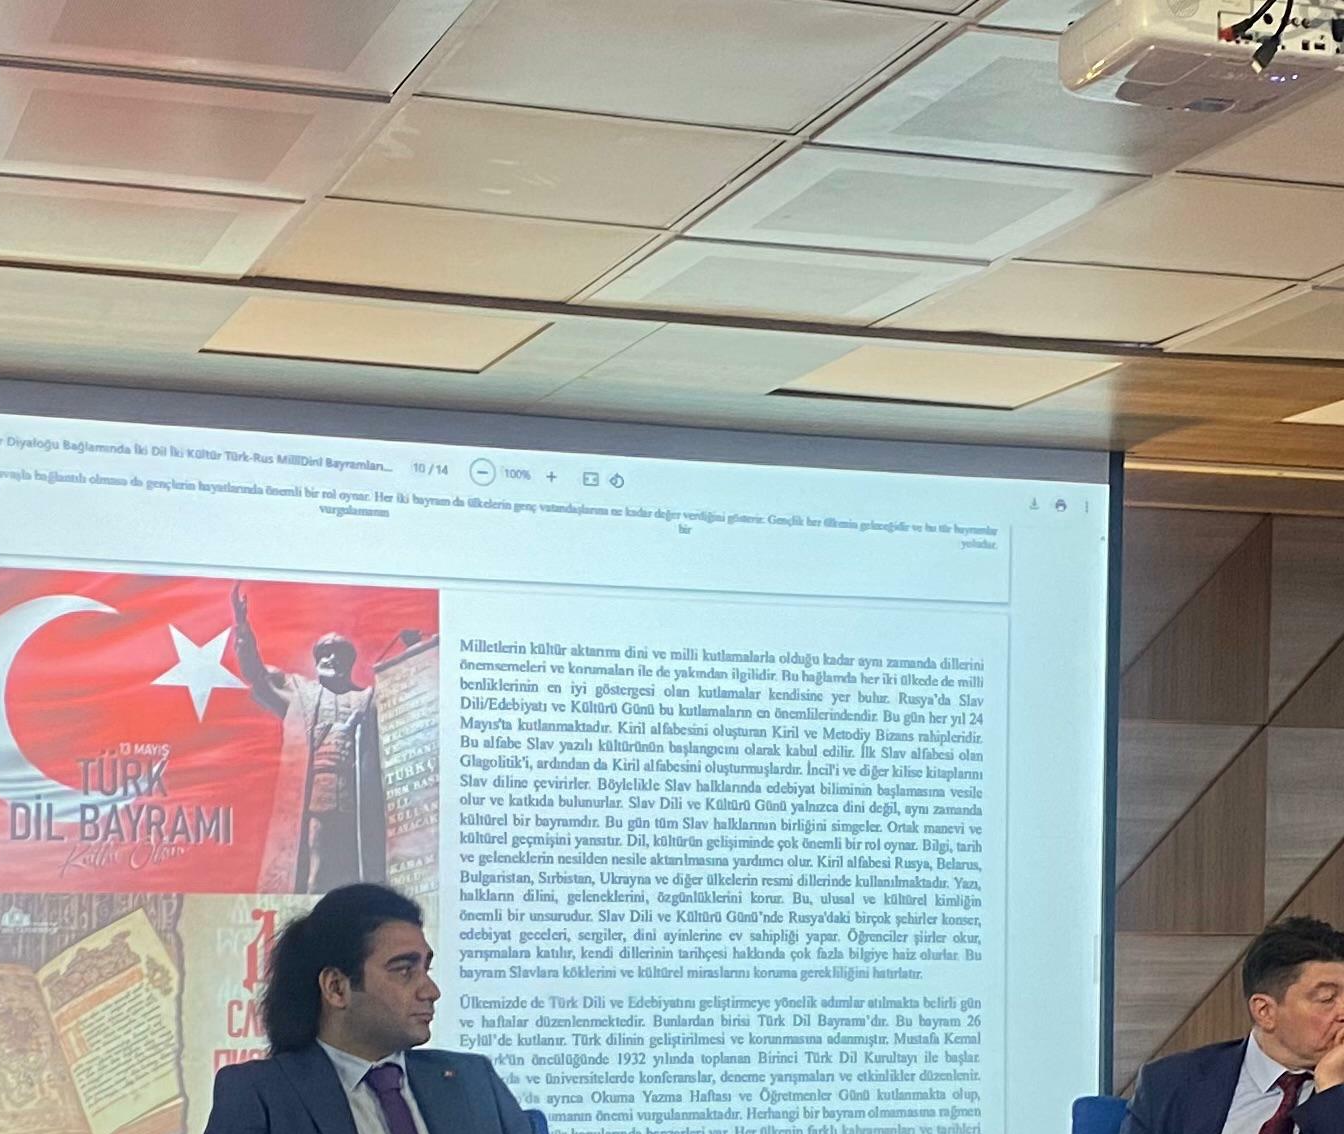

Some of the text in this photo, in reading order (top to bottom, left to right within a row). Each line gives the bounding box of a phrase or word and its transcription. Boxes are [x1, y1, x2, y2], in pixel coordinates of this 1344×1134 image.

[151, 445, 166, 456] Dil
[504, 468, 531, 480] 100%
[459, 677, 538, 693] benliklerinin
[546, 683, 561, 693] en
[570, 681, 586, 698] iyi
[595, 682, 655, 700] göstergesi
[663, 683, 689, 697] olan
[697, 684, 761, 700] kutlamalar
[768, 687, 823, 702] kendisine
[831, 693, 851, 706] yer
[958, 693, 983, 707] Slav
[460, 696, 547, 715] Dili/Edebiyatı
[551, 702, 565, 712] ve
[570, 699, 617, 714] Kültürü
[621, 701, 655, 715] Günü
[658, 702, 674, 716] bu
[678, 703, 752, 718] kutlamaların
[755, 709, 770, 718] en
[882, 709, 900, 722] Bu
[902, 710, 925, 726] gün
[928, 710, 948, 724] her
[950, 711, 966, 728] yıl
[969, 712, 983, 725] 24
[617, 720, 645, 734] Kiril
[649, 721, 708, 736] alfabesini
[712, 723, 767, 741] oluşturan
[771, 725, 799, 738] Kiril
[803, 729, 817, 739] ve
[875, 728, 914, 742] Bizans
[459, 734, 479, 748] Bu
[482, 735, 521, 749] alfabe
[526, 736, 554, 750] Slav
[558, 737, 592, 755] yazılı
[597, 738, 664, 753] kültürünün
[743, 742, 781, 756] olarak
[785, 743, 817, 757] kabul
[880, 746, 906, 759] Slav
[910, 747, 954, 761] alfabesi
[958, 748, 983, 761] olan
[76, 750, 169, 798] TÜRK
[459, 773, 487, 787] Slav
[492, 774, 528, 788] diline
[596, 776, 661, 794] Böylelikle
[664, 778, 691, 792] Slav
[695, 779, 761, 793] halklarında
[765, 780, 815, 798] edebiyat
[819, 782, 872, 796] biliminin
[949, 785, 983, 798] vesile
[10, 794, 234, 847] DİL BAYRAMI
[599, 871, 651, 888] Ukrayna
[654, 875, 668, 885] ve
[671, 872, 703, 889] diğer
[706, 872, 758, 886] ülkelerin
[760, 874, 793, 887] resmi
[796, 874, 852, 887] dillerinde
[459, 887, 514, 901] halkların
[820, 892, 854, 905] ulusal
[862, 896, 876, 905] ve
[883, 893, 927, 906] kültürel
[934, 893, 981, 910] kimliğin
[459, 1017, 473, 1027] ve
[481, 1013, 528, 1027] haftalar
[652, 1014, 714, 1027] Bunlardan
[720, 1014, 750, 1027] birisi
[760, 1014, 785, 1027] Türk
[792, 1014, 810, 1027] Dil
[895, 1014, 912, 1027] Bu
[918, 1014, 961, 1030] bayram
[967, 1014, 981, 1027] 26
[571, 1032, 601, 1045] Türk
[605, 1032, 644, 1045] dilinin
[648, 1032, 725, 1048] geliştirilmesi
[730, 1036, 744, 1045] ve
[893, 1032, 939, 1045] Mustafa
[943, 1032, 981, 1045] Kemal
[530, 1051, 609, 1068] öncülüğünde
[617, 1051, 646, 1064] 1932
[652, 1051, 694, 1068] yılında
[700, 1051, 751, 1067] toplanan
[757, 1051, 798, 1064] Birinci
[806, 1051, 832, 1064] Türk
[838, 1051, 857, 1064] Dil
[863, 1051, 917, 1067] Kurultayı
[923, 1051, 938, 1063] ile
